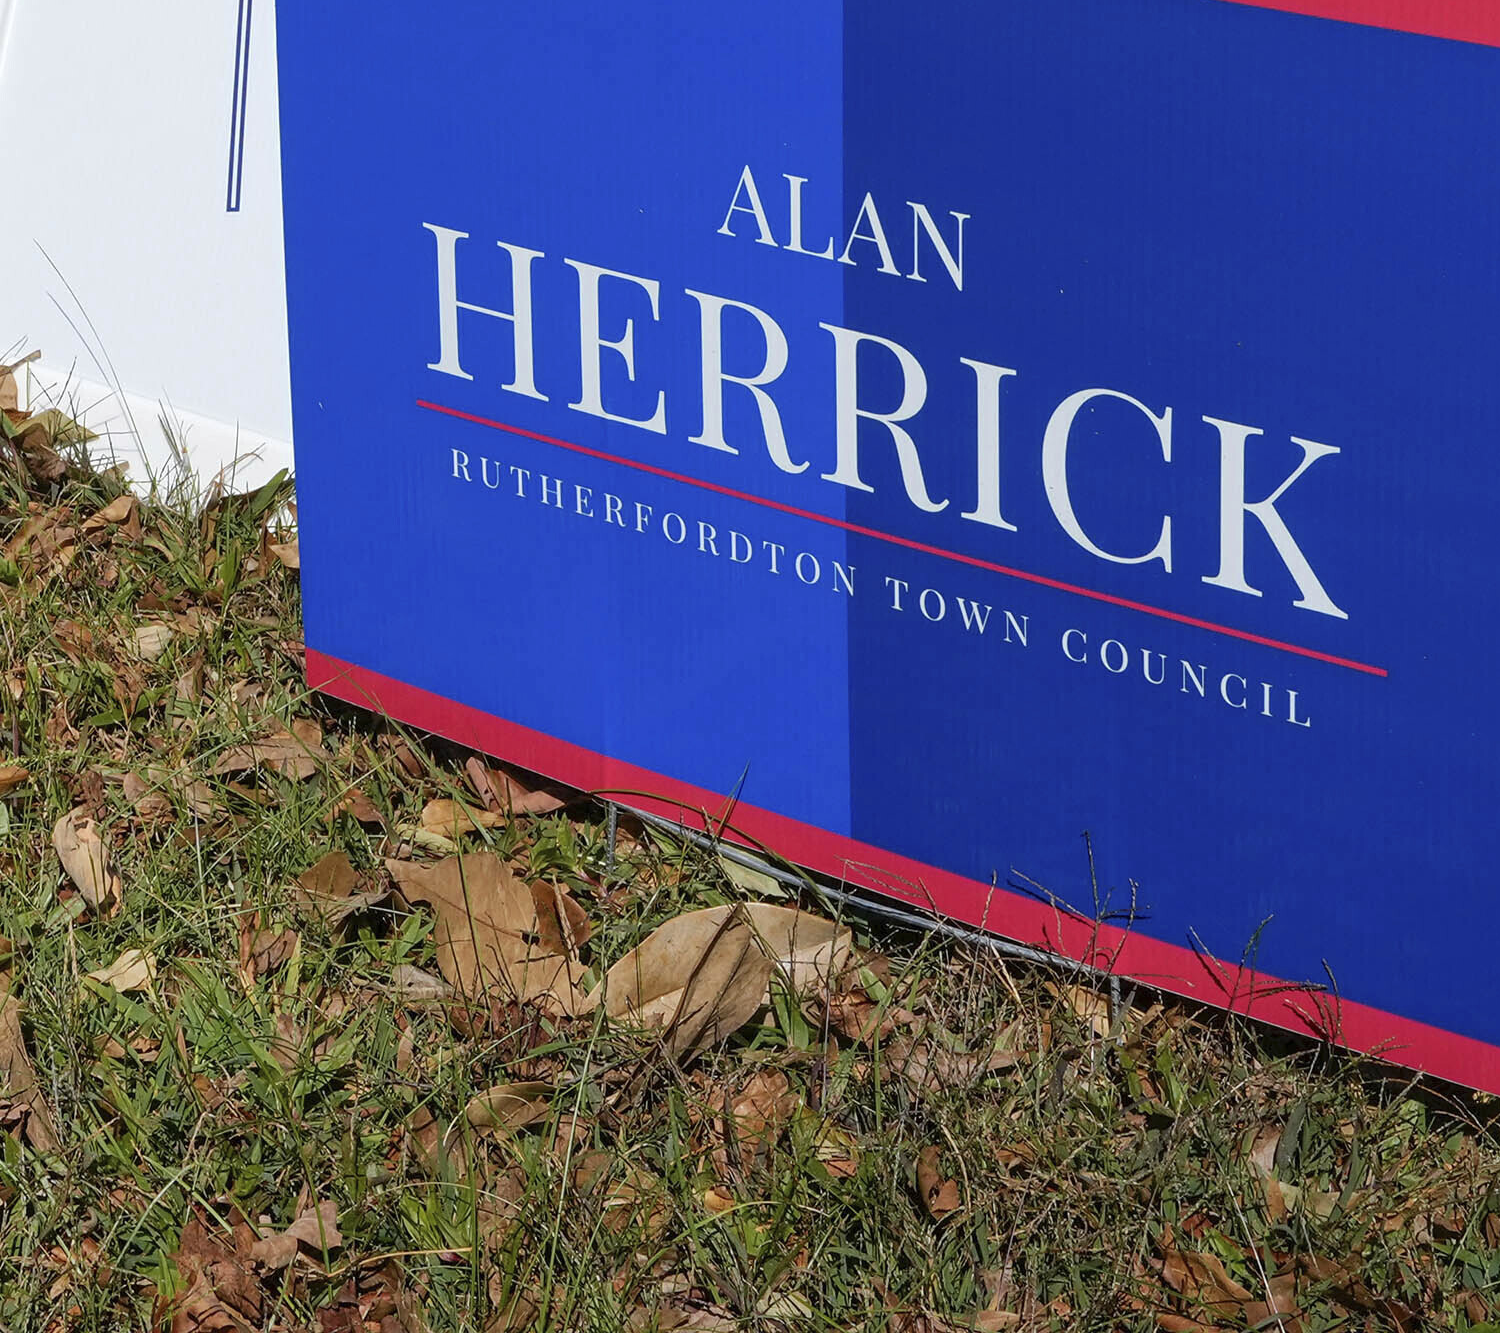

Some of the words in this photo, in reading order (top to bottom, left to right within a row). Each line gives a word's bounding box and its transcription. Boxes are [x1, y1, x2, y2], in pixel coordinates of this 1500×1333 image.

[717, 164, 970, 292] ALAN
[422, 220, 1348, 621] HERRICK
[450, 447, 858, 598] RUTHERFORDTON
[885, 574, 1031, 648] TOWN
[1062, 626, 1311, 729] COUNCIL
